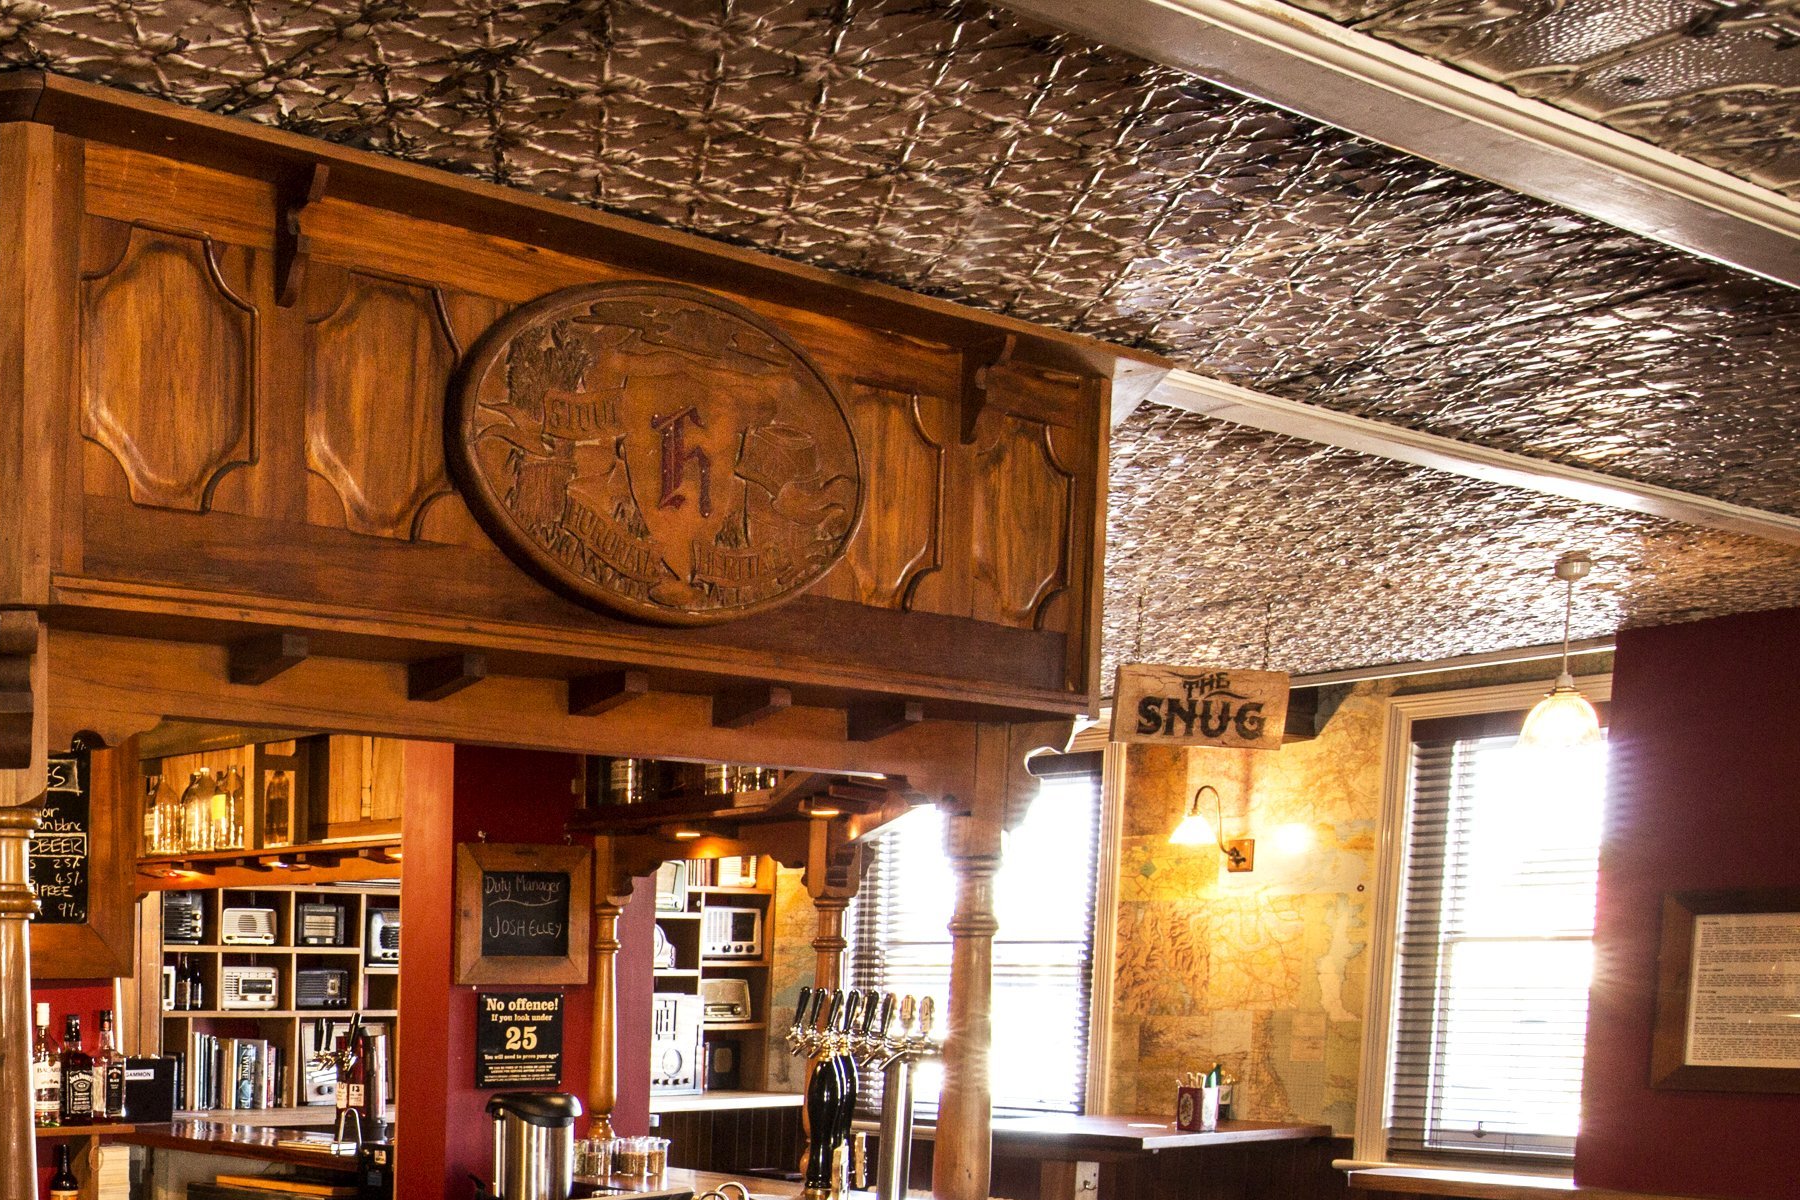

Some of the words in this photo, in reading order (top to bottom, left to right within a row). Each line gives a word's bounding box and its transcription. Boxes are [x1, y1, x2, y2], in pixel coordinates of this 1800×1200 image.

[1182, 671, 1231, 700] THE
[1135, 695, 1267, 741] SNUG
[41, 884, 74, 898] FREE
[484, 875, 512, 901] Duty
[515, 873, 561, 903] Manager
[488, 915, 526, 938] JOSH
[485, 997, 506, 1012] No
[507, 997, 560, 1012] offence!
[490, 1013, 499, 1022] If
[498, 1014, 513, 1024] you
[514, 1013, 531, 1022] look
[531, 1012, 554, 1022] under
[504, 1025, 539, 1051] 25
